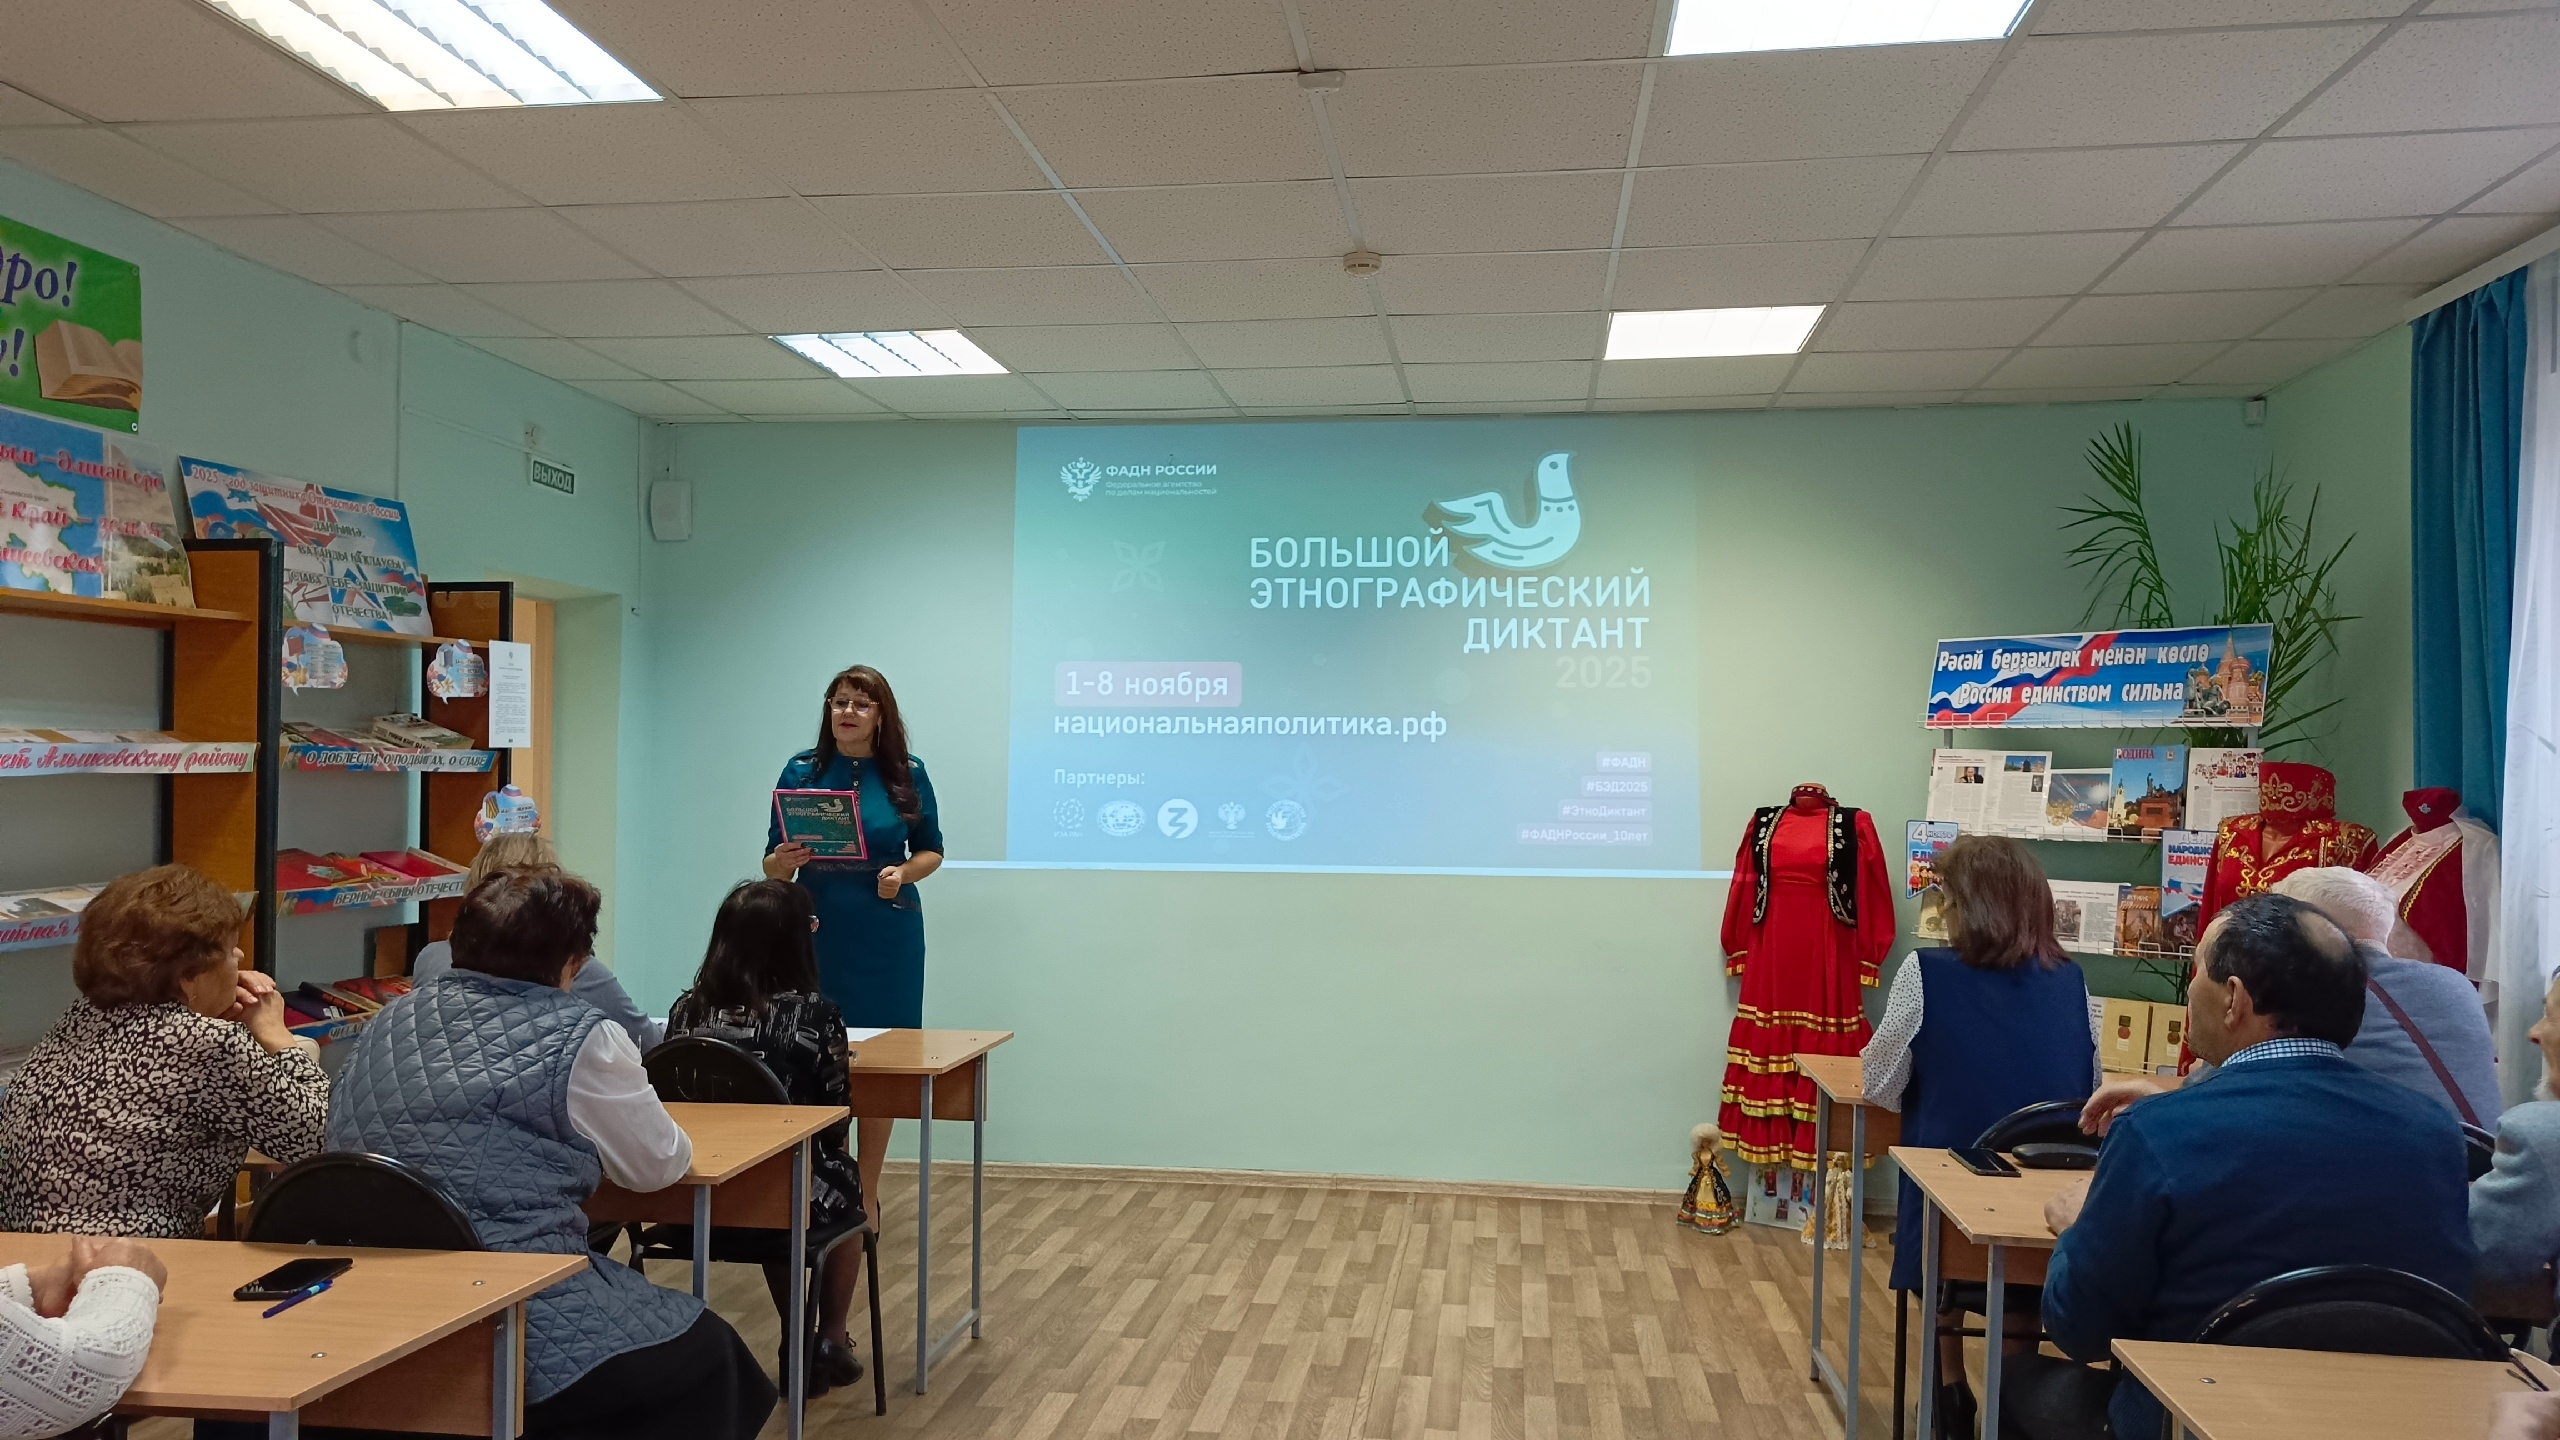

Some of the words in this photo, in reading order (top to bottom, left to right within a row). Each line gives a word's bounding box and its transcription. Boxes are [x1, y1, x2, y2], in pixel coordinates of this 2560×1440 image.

[0, 246, 77, 307] ро!
[533, 463, 573, 493] ВЫХОД
[1105, 464, 1151, 477] ФАДН
[1155, 464, 1217, 476] РОССИИ
[192, 466, 219, 484] 2025
[248, 480, 306, 502] защитника
[307, 490, 361, 513] Отечества
[1105, 481, 1162, 489] Федеральное
[1162, 481, 1203, 489] агентство
[1105, 489, 1116, 497] по
[1116, 489, 1143, 498] делам
[1249, 527, 1450, 568] БОЛЬШОЙ
[1249, 567, 1651, 609] ЭТНОГРАФИЧЕСКИЙ
[1463, 617, 1650, 655] ДИКТАНТ
[2090, 647, 2146, 667] менән
[2156, 643, 2209, 665] көслө
[1555, 655, 1652, 689] 2025
[1124, 671, 1230, 703] ноября
[1957, 683, 2013, 706] Россия
[2020, 681, 2113, 705] единством
[2121, 680, 2184, 702] сильна
[1053, 710, 1448, 743] национальнаяполитика.рф
[184, 747, 249, 773] району
[306, 751, 317, 764] О
[383, 752, 392, 765] О
[448, 755, 457, 766] О
[458, 755, 488, 766] СЛАВЕ
[1601, 756, 1647, 769] #ФАДН
[2115, 748, 2155, 761] РОДИНА
[1053, 768, 1146, 788] Партнеры:
[1586, 781, 1648, 793] #БЭД2025
[1562, 804, 1647, 818] #ЭтноДиктант
[1520, 829, 1649, 843] #ФАДНРоссии_10лет
[1911, 822, 1928, 844] 4
[2167, 843, 2213, 856] НАРОДНО
[2167, 853, 2210, 867] ЕДИНСТ
[334, 890, 381, 906] ВЕРНЫЕ
[382, 886, 414, 900] СЫНЫ
[416, 881, 465, 895] ОТЕЧЕСТ
